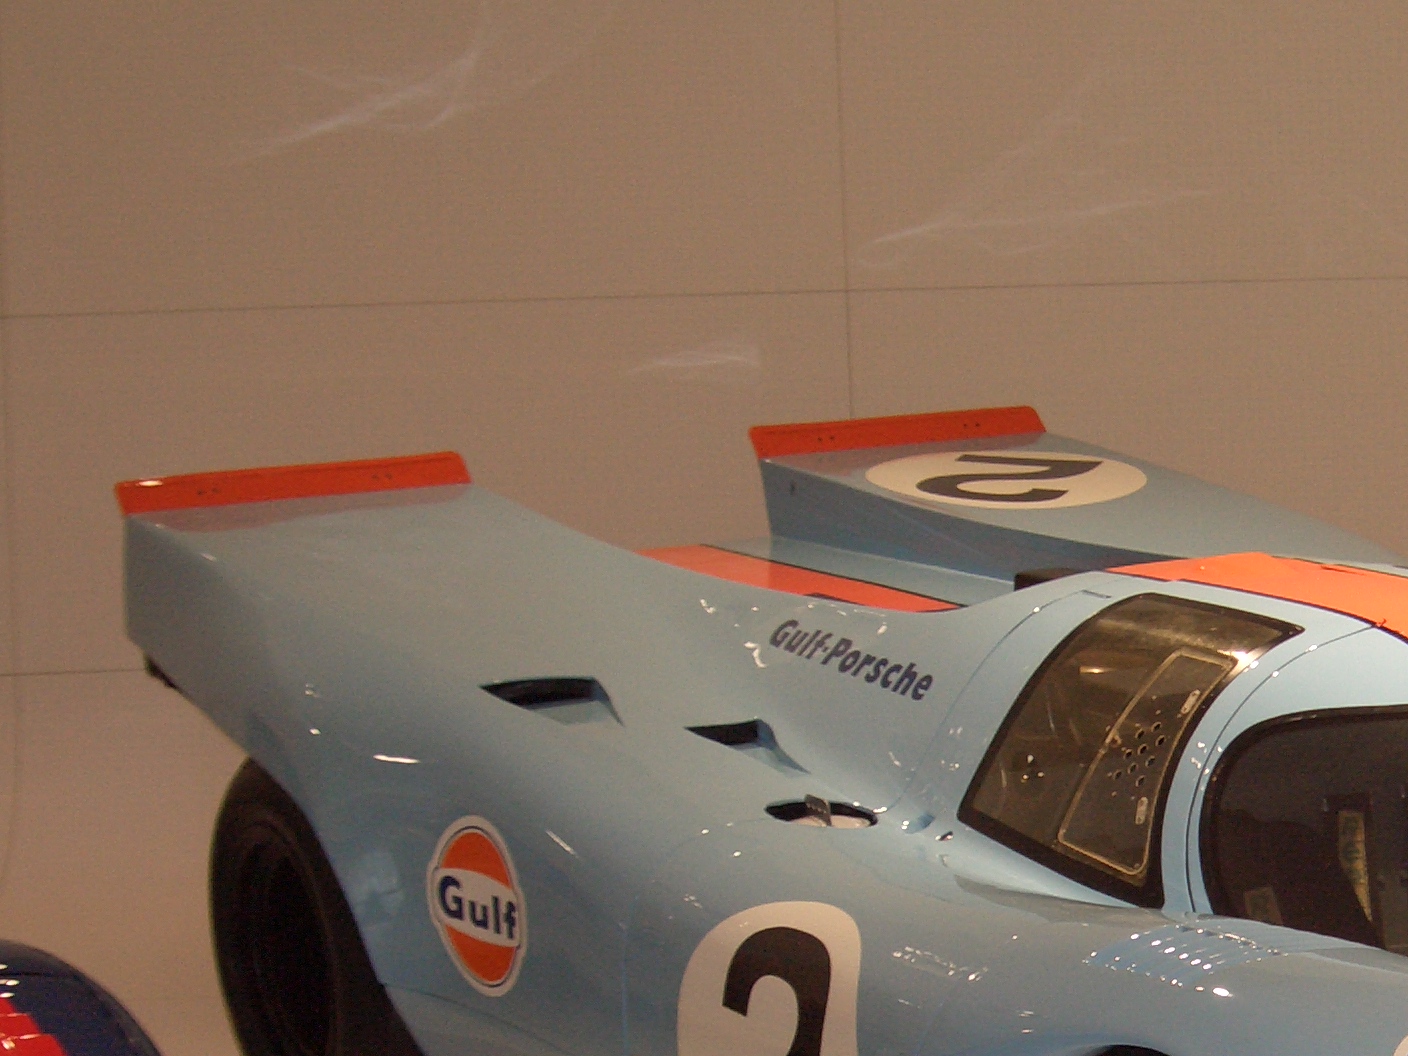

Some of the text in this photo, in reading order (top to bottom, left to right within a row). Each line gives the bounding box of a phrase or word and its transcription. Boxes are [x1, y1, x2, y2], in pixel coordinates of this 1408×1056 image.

[916, 455, 1103, 502] 2
[769, 619, 934, 701] Gulf-Porsche
[438, 875, 520, 940] Gulf
